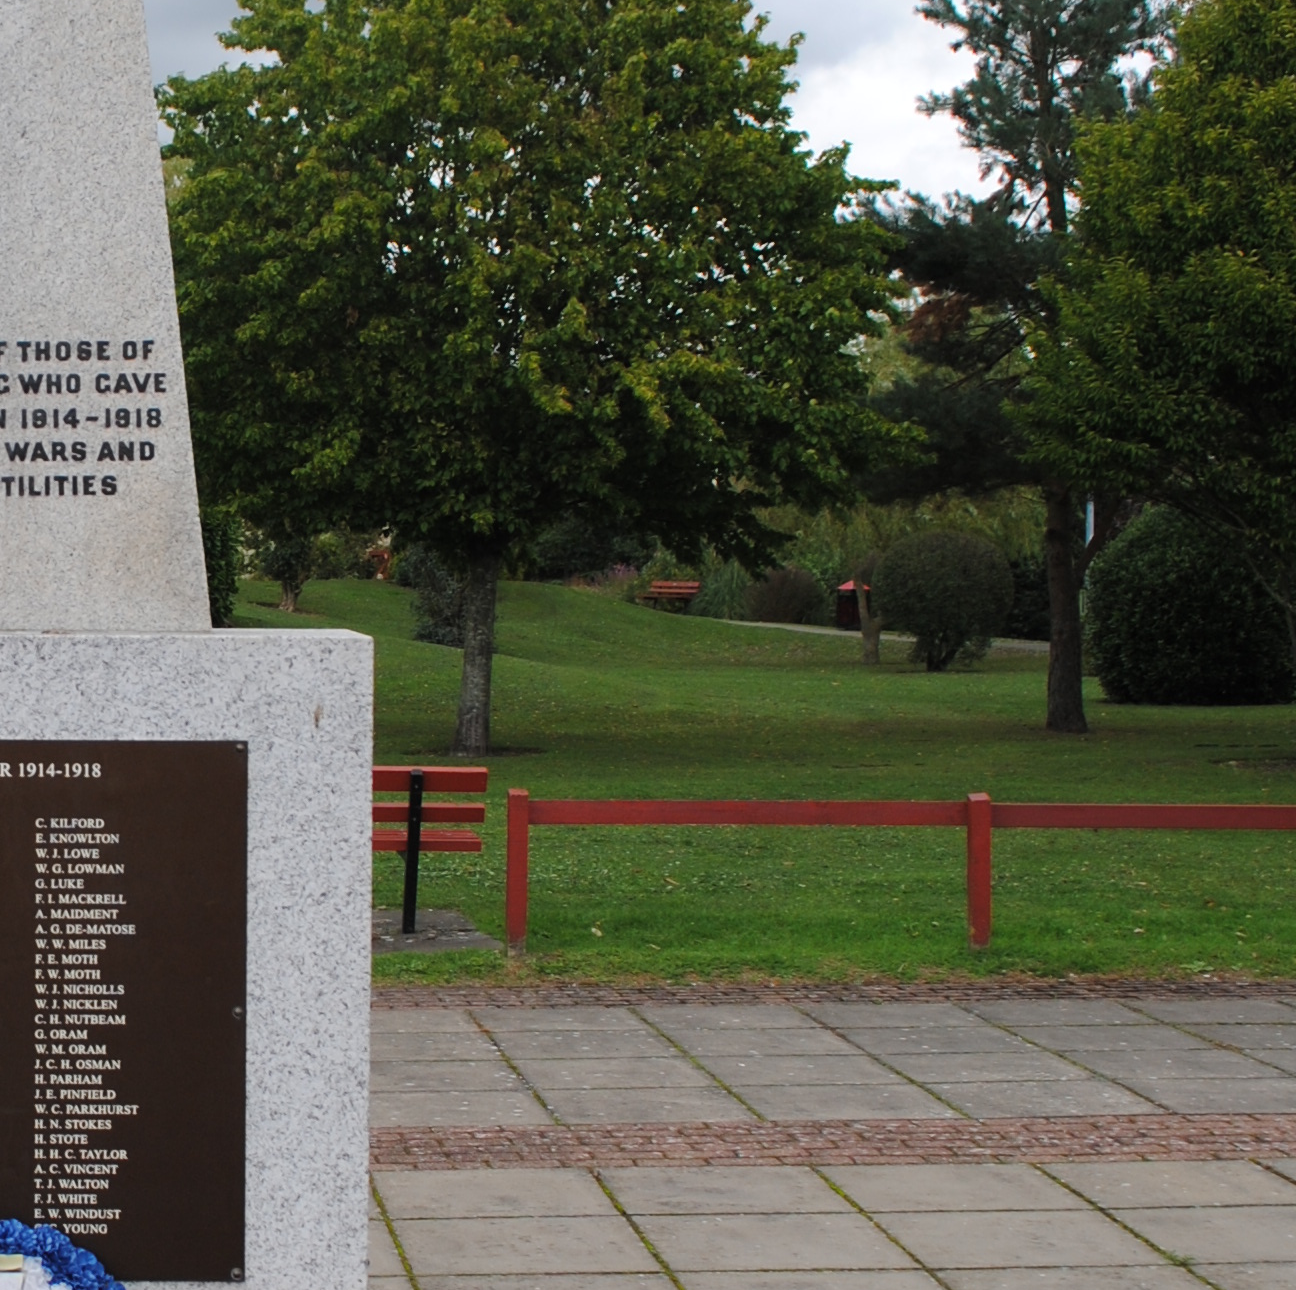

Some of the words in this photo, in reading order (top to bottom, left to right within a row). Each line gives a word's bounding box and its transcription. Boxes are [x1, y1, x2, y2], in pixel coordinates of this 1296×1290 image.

[16, 341, 110, 363] THOSE
[122, 340, 155, 360] OF
[18, 373, 81, 395] WHO
[95, 373, 166, 394] GAVE
[21, 408, 162, 429] 1914-1918
[4, 441, 87, 462] WARS
[97, 441, 155, 462] AND
[19, 763, 101, 778] 1914-1918
[35, 818, 47, 828] C.
[50, 818, 105, 829] KILFORD
[35, 833, 46, 843] E.
[50, 833, 119, 844] KNOWLTON
[35, 848, 49, 858] W.
[52, 848, 61, 859] J.
[64, 848, 100, 859] LOWE
[35, 863, 49, 873] W.
[52, 863, 64, 874] G.
[68, 863, 124, 874] LOWMAN
[35, 878, 48, 889] G.
[51, 878, 84, 889] LUKE
[35, 909, 47, 919] A.
[51, 909, 119, 919] MAIDMENT
[35, 924, 47, 934] A.
[50, 924, 63, 934] G.
[66, 924, 136, 935] DE-MATOSE
[35, 939, 49, 949] W.
[52, 939, 66, 949] W.
[69, 939, 106, 950] MILES
[35, 969, 44, 979] F.
[47, 969, 61, 979] W.
[64, 969, 101, 980] MOTH
[35, 984, 49, 994] W.
[52, 984, 60, 994] J.
[63, 984, 125, 995] NICHOLLS
[34, 1014, 47, 1024] C.
[49, 1014, 62, 1024] H.
[65, 1014, 126, 1025] NUTBEAM
[34, 1029, 47, 1039] G.
[50, 1029, 88, 1040] ORAM
[35, 1044, 49, 1054] W.
[51, 1044, 66, 1054] M.
[68, 1044, 107, 1055] ORAM
[34, 1059, 43, 1069] J.
[45, 1059, 58, 1069] C.
[61, 1059, 73, 1069] H.
[76, 1059, 121, 1070] OSMAN
[35, 1074, 47, 1084] H.
[50, 1074, 102, 1085] PARHAM
[34, 1104, 48, 1114] W.
[51, 1104, 63, 1114] C.
[66, 1104, 139, 1115] PARKHURST
[34, 1119, 46, 1129] H.
[50, 1119, 62, 1129] N.
[65, 1119, 112, 1130] STOKES
[34, 1134, 47, 1144] H.
[50, 1134, 88, 1145] STOTE
[34, 1149, 46, 1159] H.
[50, 1149, 62, 1159] H.
[64, 1149, 76, 1159] C.
[79, 1149, 128, 1160] TAYLOR
[34, 1164, 46, 1174] A.
[49, 1164, 61, 1174] C.
[64, 1164, 119, 1175] VINCENT
[34, 1208, 45, 1218] E.
[48, 1208, 61, 1218] W.
[64, 1209, 121, 1219] WINDUST
[63, 1223, 108, 1234] YOUNG
